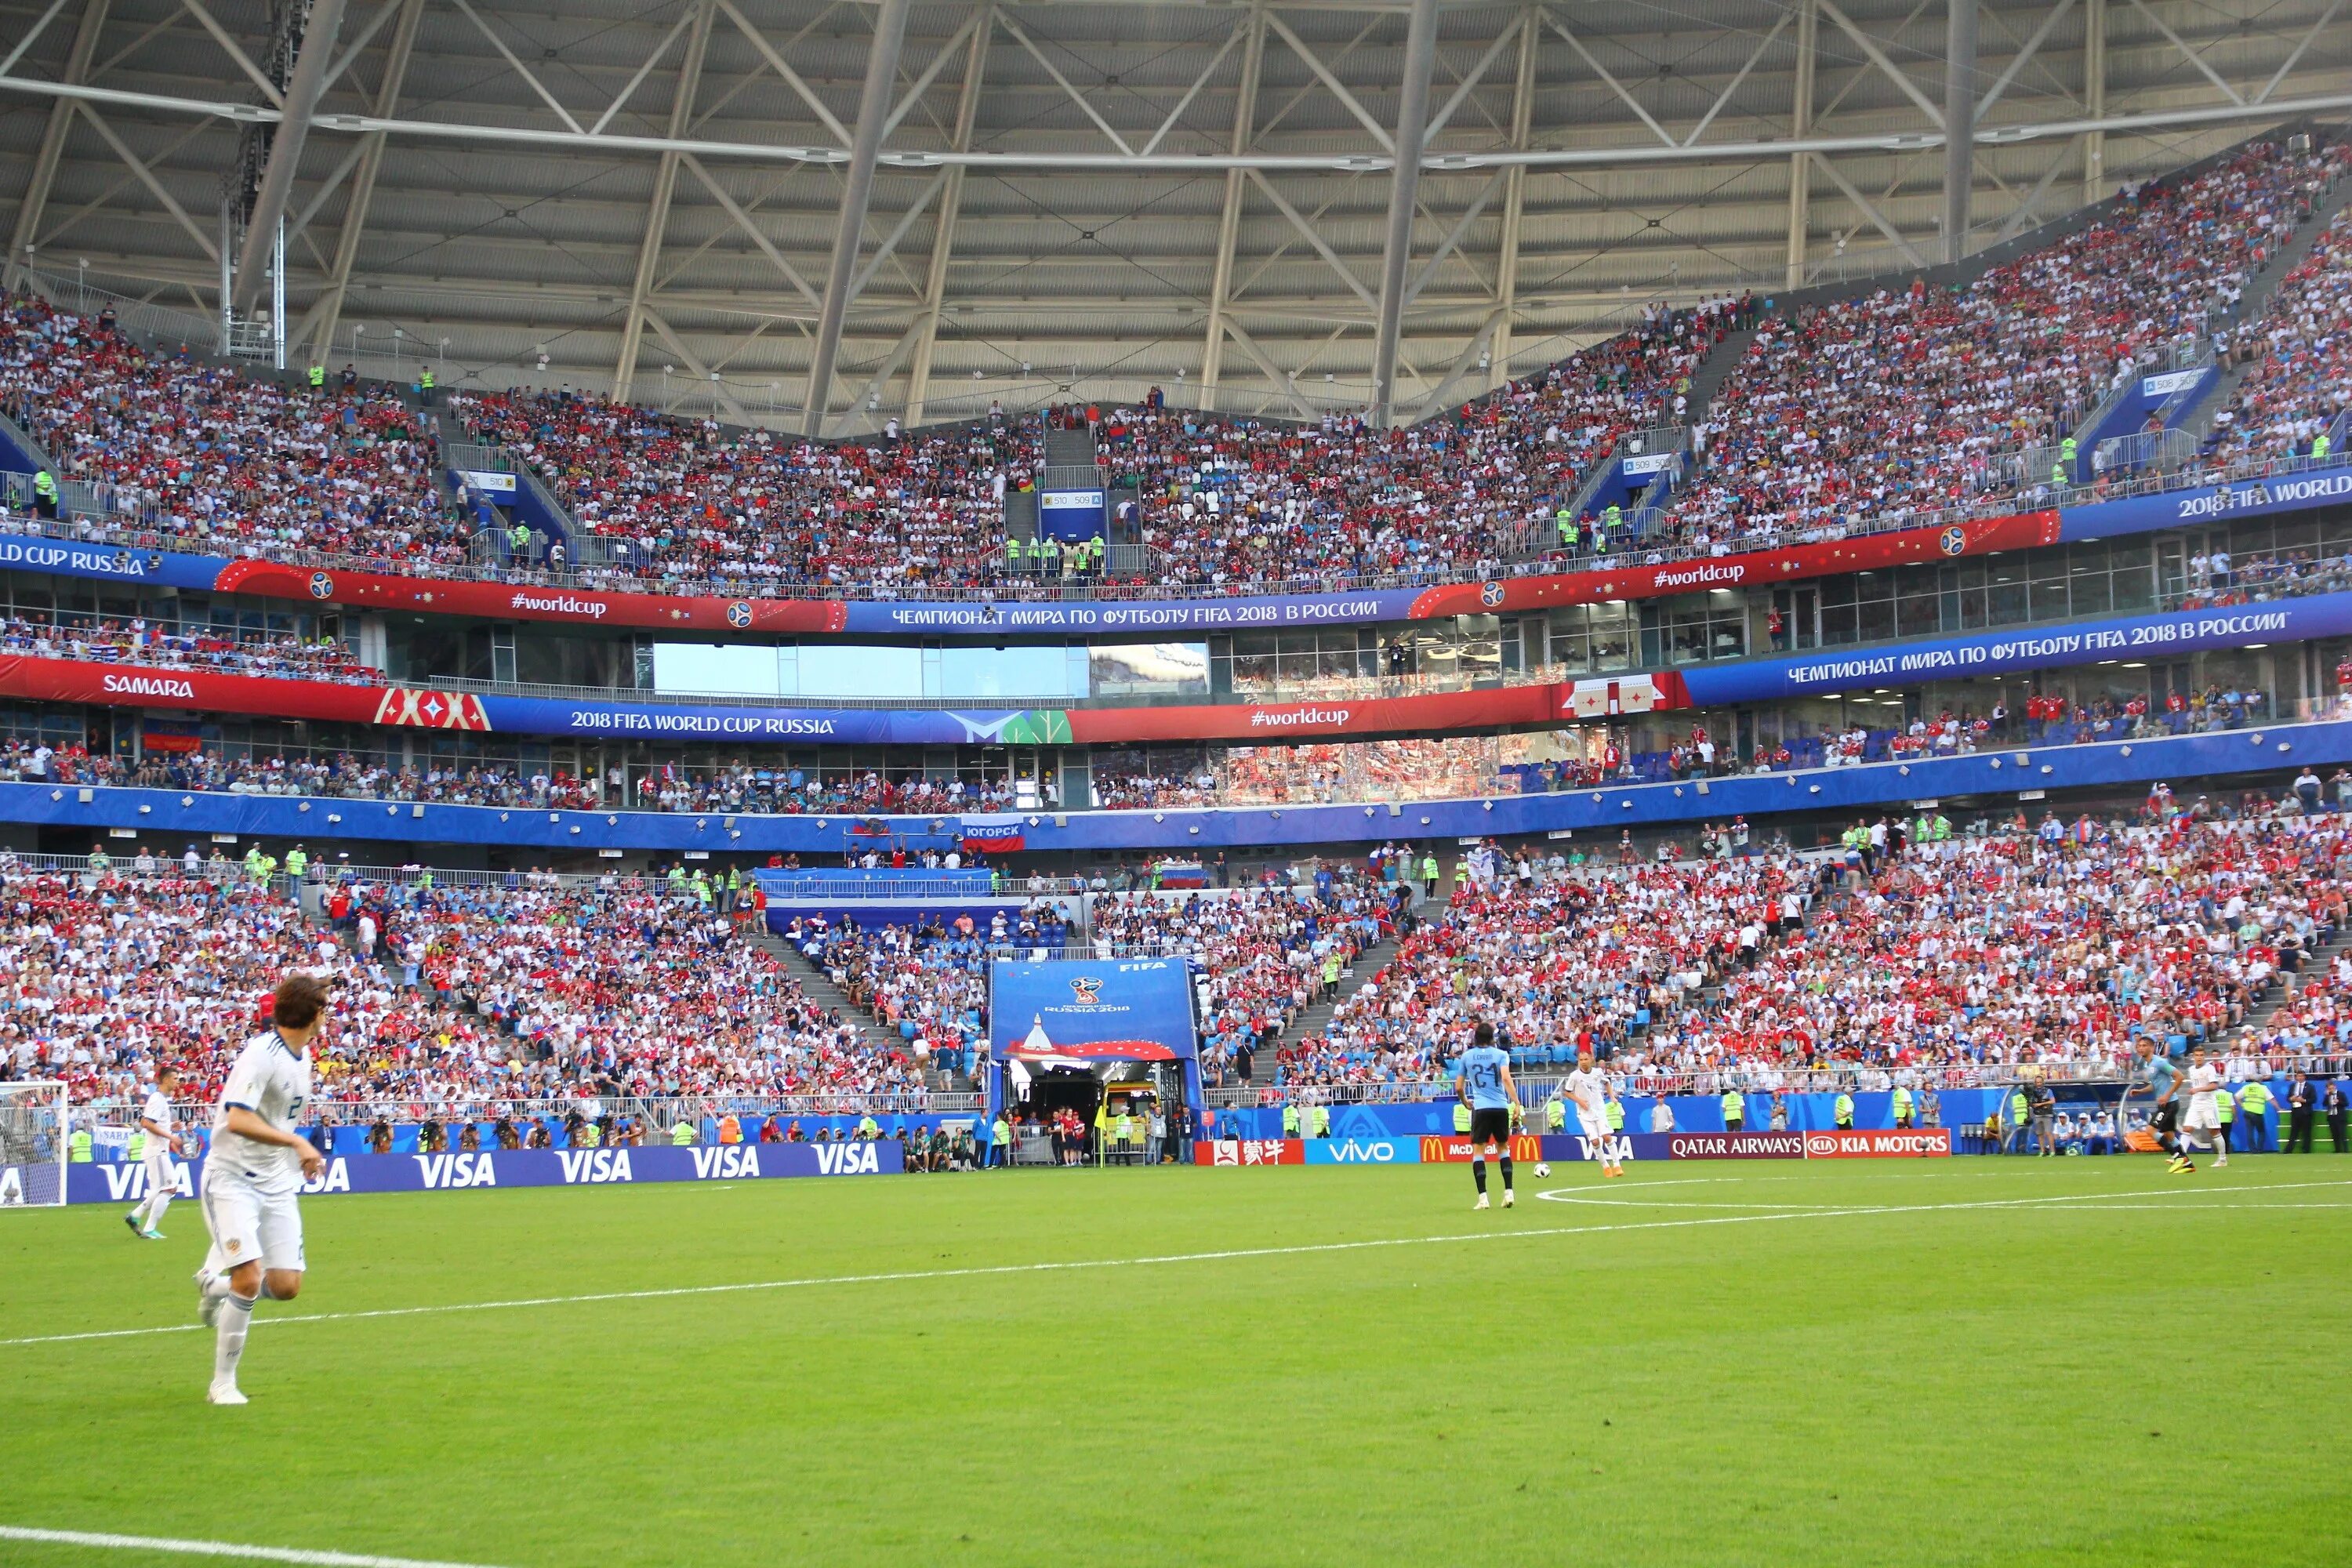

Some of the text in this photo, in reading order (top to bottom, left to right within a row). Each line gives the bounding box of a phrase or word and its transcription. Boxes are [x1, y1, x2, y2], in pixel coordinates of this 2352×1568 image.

[2158, 379, 2173, 389] 508
[1635, 460, 1650, 469] 509
[2179, 475, 2352, 517] 2018 FIFA WORLD
[26, 546, 68, 566] CUP
[72, 551, 144, 576] RUSSIA
[1654, 564, 1744, 587] #worldcup
[511, 592, 607, 619] #worldcup
[892, 601, 1377, 625] ЧЕМПИОНАТ МИРА ПО ФУТБОЛУ FIFA 2018 В РОССИИ
[1788, 612, 2285, 683] ЧЕМПИОНАТ МИРА ПО ФУТБОЛУ FIFA 2018 В РОССИИ
[103, 674, 194, 699] SAMARA
[571, 711, 834, 734] 2018 FIFA WORLD CUP RUSSIA
[1251, 707, 1349, 727] #worldcup
[967, 826, 1019, 837] ЮГОРСК
[1120, 961, 1167, 972] FIFA
[1472, 1062, 1499, 1089] 21
[287, 1096, 303, 1120] 2
[1243, 1139, 1285, 1165] 蒙牛
[1672, 1137, 1802, 1157] QATAR AIRWAYS
[1813, 1140, 1834, 1151] KIA
[1841, 1135, 1947, 1152] KIA MOTORS
[554, 1149, 633, 1183] VISA
[687, 1145, 760, 1178] VISA
[811, 1142, 879, 1174] VISA
[412, 1152, 495, 1189] VISA
